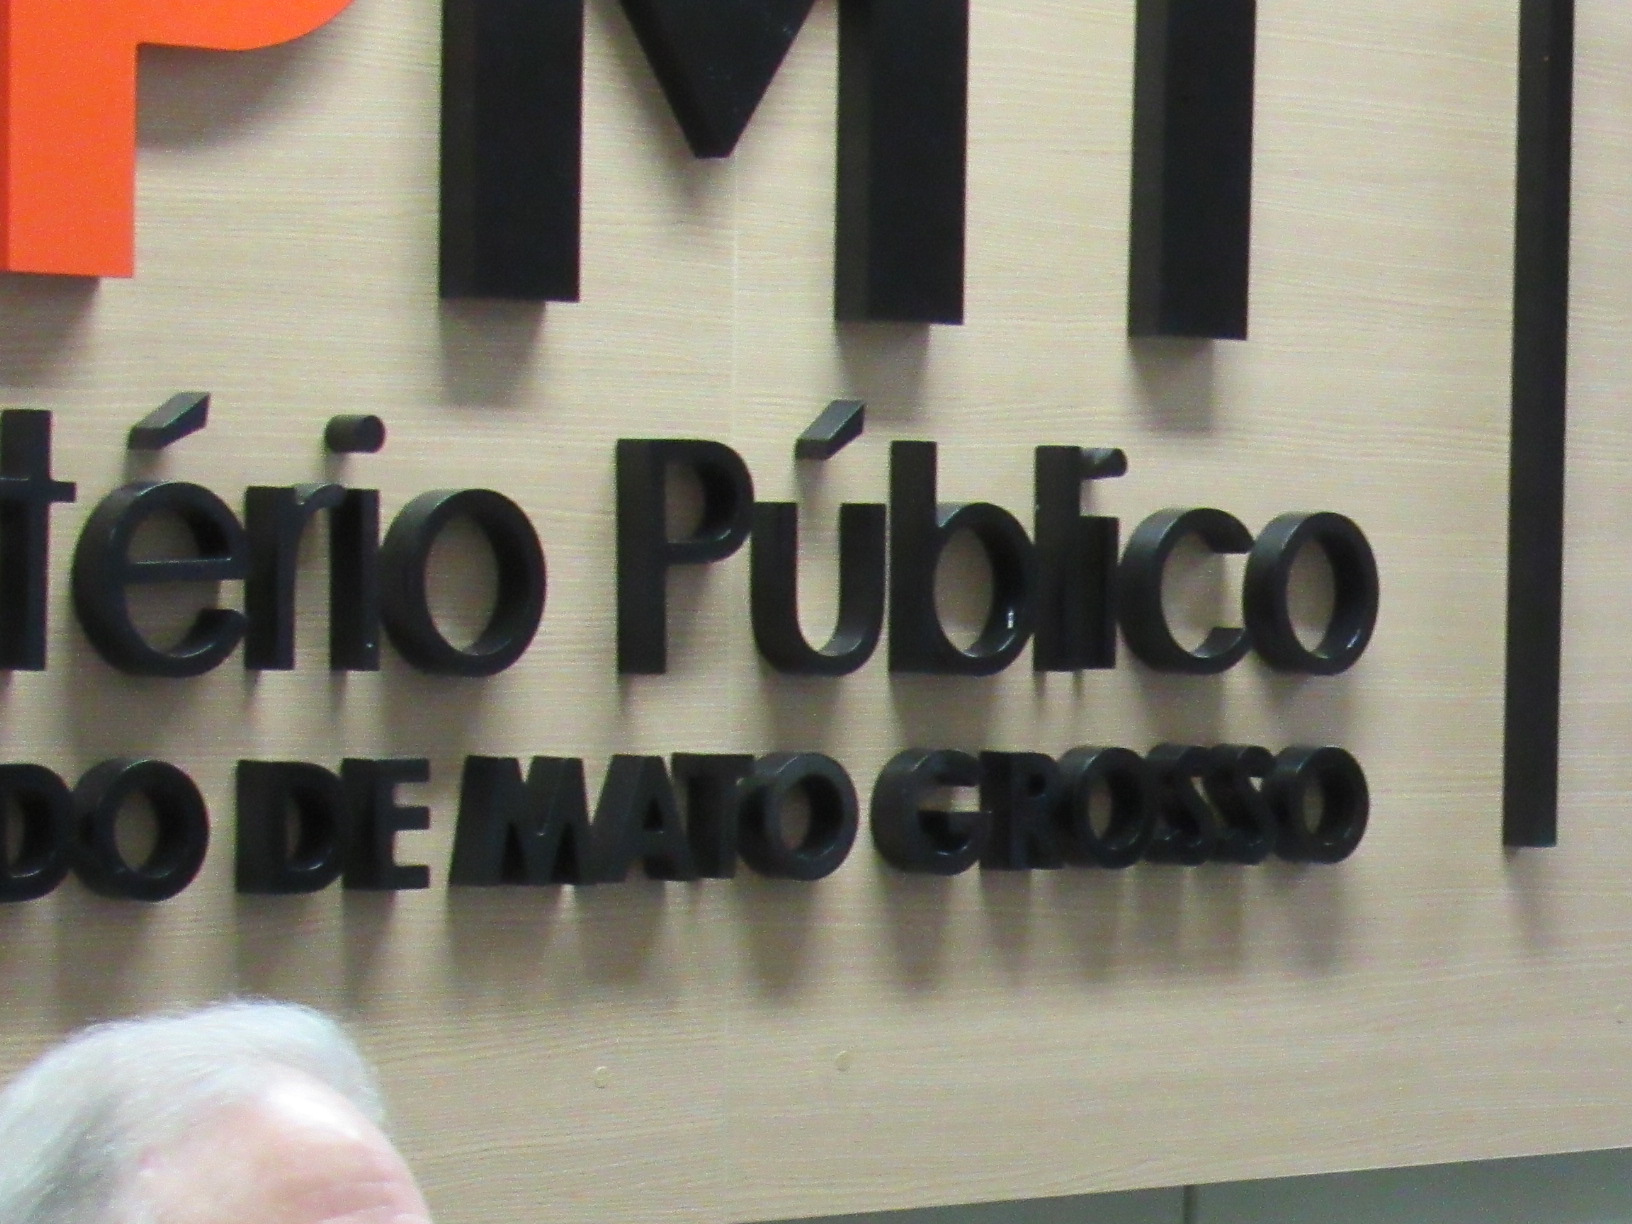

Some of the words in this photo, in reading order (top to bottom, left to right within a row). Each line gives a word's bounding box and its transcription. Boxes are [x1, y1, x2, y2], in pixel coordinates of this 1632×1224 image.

[0, 392, 546, 678] tério
[617, 400, 1379, 677] Público
[0, 757, 209, 903] DO
[236, 759, 431, 895] DE
[449, 752, 859, 887] MATO
[870, 744, 1371, 876] GROSSO
